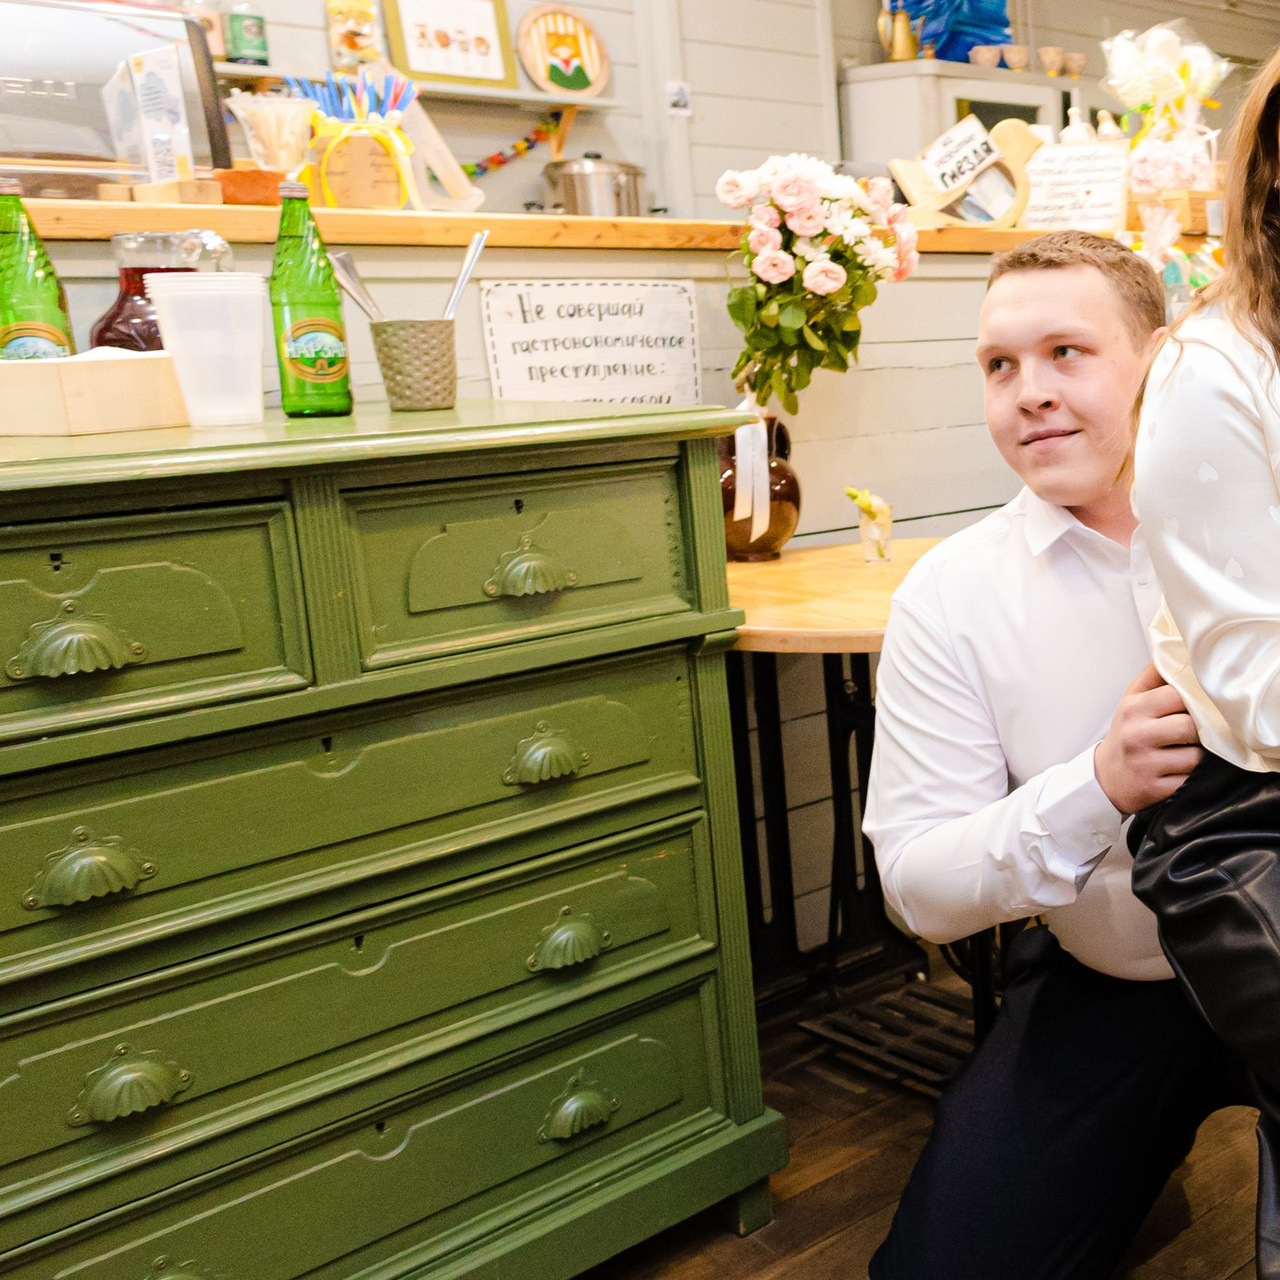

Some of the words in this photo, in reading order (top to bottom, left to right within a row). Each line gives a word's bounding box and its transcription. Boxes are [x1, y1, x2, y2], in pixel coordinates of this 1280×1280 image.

[517, 292, 546, 324] Не
[556, 297, 645, 322] совершай
[528, 362, 667, 383] преступление:
